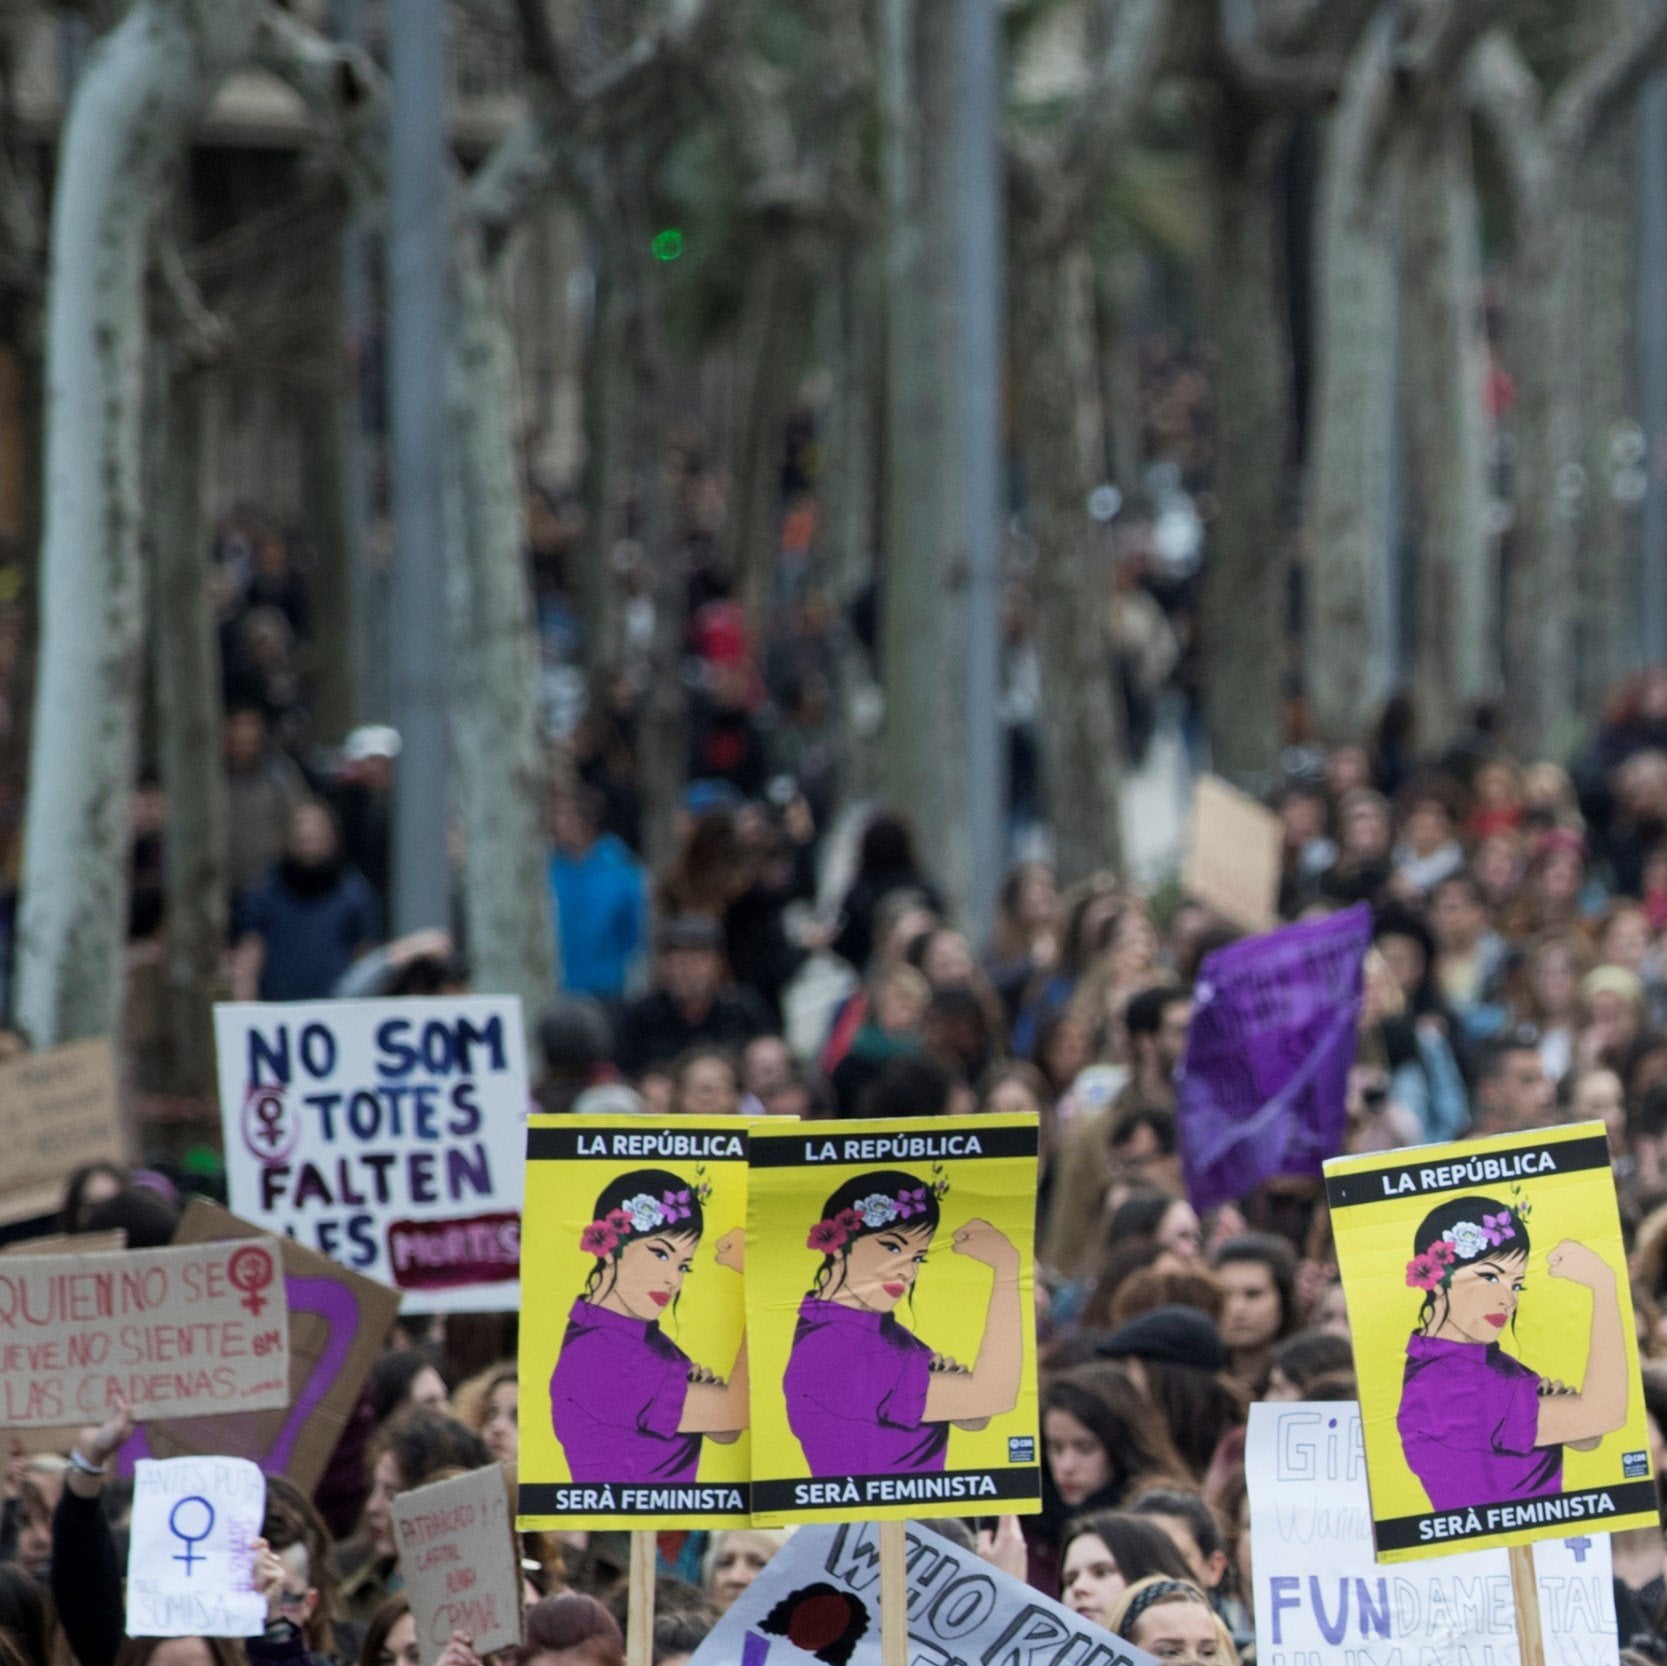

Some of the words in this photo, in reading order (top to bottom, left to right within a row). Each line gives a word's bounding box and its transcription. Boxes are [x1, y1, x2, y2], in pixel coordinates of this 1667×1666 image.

[249, 1024, 336, 1087] NO
[375, 1016, 506, 1076] SOM
[304, 1084, 482, 1142] TOTES
[577, 1136, 606, 1156] LA
[613, 1131, 744, 1157] REPÚBLICA
[805, 1140, 837, 1161] LA
[843, 1131, 982, 1159] REPÚBLICA
[261, 1144, 493, 1211] FALTEN
[1382, 1174, 1415, 1196] LA
[1421, 1151, 1556, 1190] REPÚBLICA
[287, 1215, 378, 1266] ES
[121, 1266, 169, 1313] NO
[182, 1261, 226, 1303] SE
[68, 1331, 112, 1368] NO
[119, 1321, 246, 1365] SIENTE
[4, 1377, 64, 1421] LAS
[76, 1366, 237, 1414] CADENAS
[556, 1482, 615, 1510] SERÀ
[622, 1488, 744, 1510] FEMINISTA
[795, 1478, 859, 1505] SERÀ
[866, 1476, 997, 1502] FEMINISTA
[1418, 1510, 1481, 1541] SERÀ
[1487, 1491, 1615, 1531] FEMINISTA
[825, 1522, 996, 1641] WHO
[1270, 1576, 1618, 1645] FUNDAMETAL
